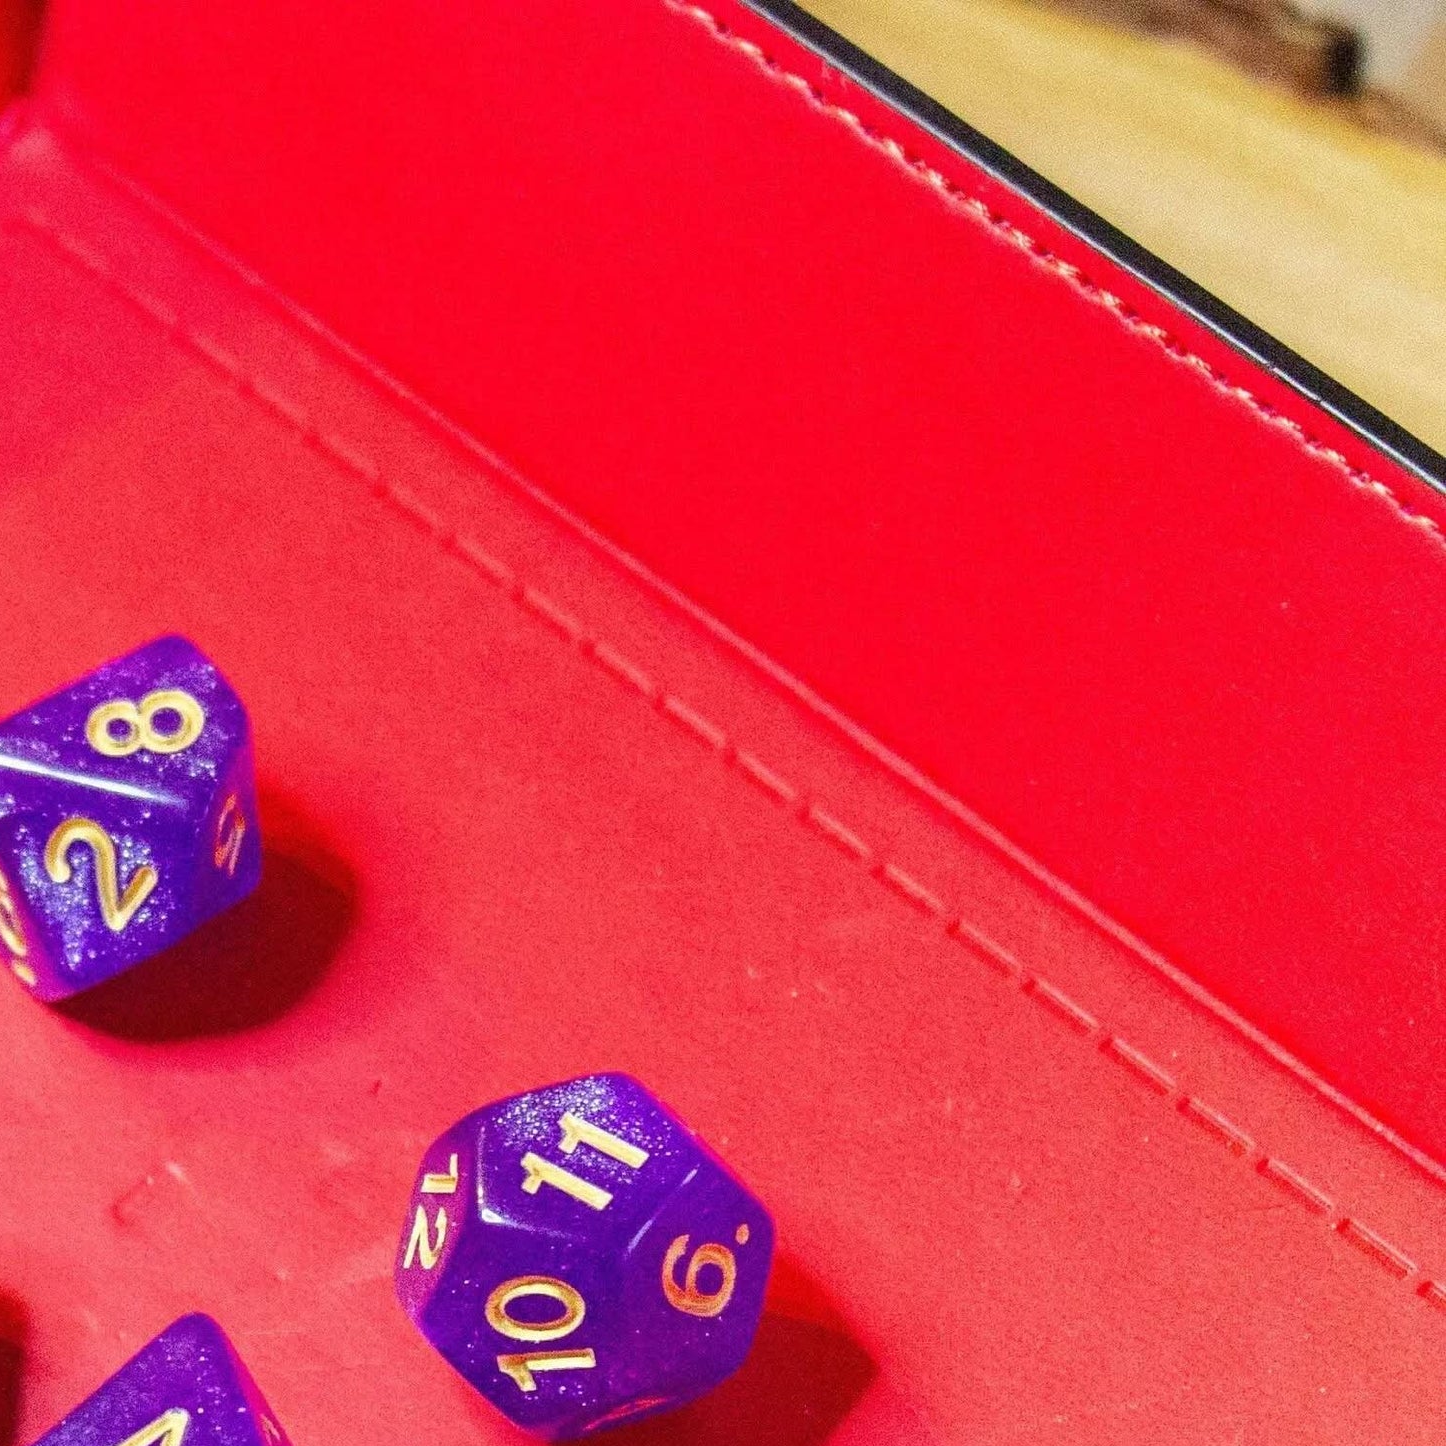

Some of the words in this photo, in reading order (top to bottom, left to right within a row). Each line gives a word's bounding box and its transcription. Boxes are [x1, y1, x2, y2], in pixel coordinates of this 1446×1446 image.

[86, 689, 205, 757] 8
[43, 817, 158, 931] 2
[402, 1152, 458, 1270] 12
[520, 1112, 650, 1211] 11
[484, 1275, 597, 1392] 10
